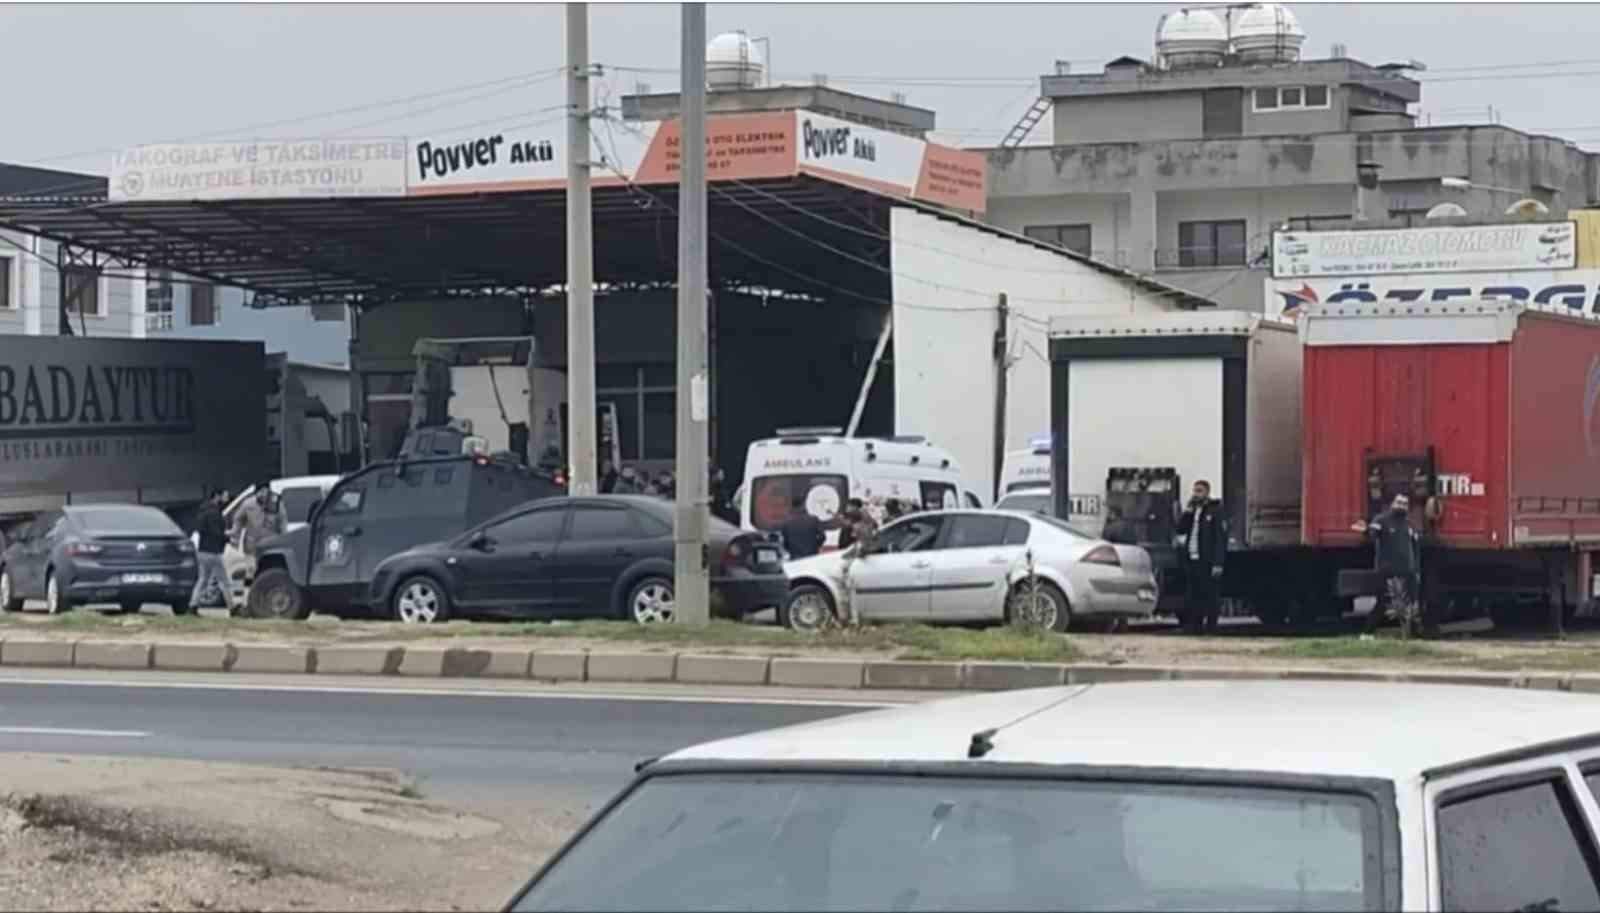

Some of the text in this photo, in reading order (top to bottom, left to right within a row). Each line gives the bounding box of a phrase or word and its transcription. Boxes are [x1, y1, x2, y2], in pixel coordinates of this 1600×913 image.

[510, 139, 553, 165] Akü
[764, 457, 831, 468] AMBULANS
[1437, 474, 1471, 496] TIR
[1070, 495, 1099, 515] TIR
